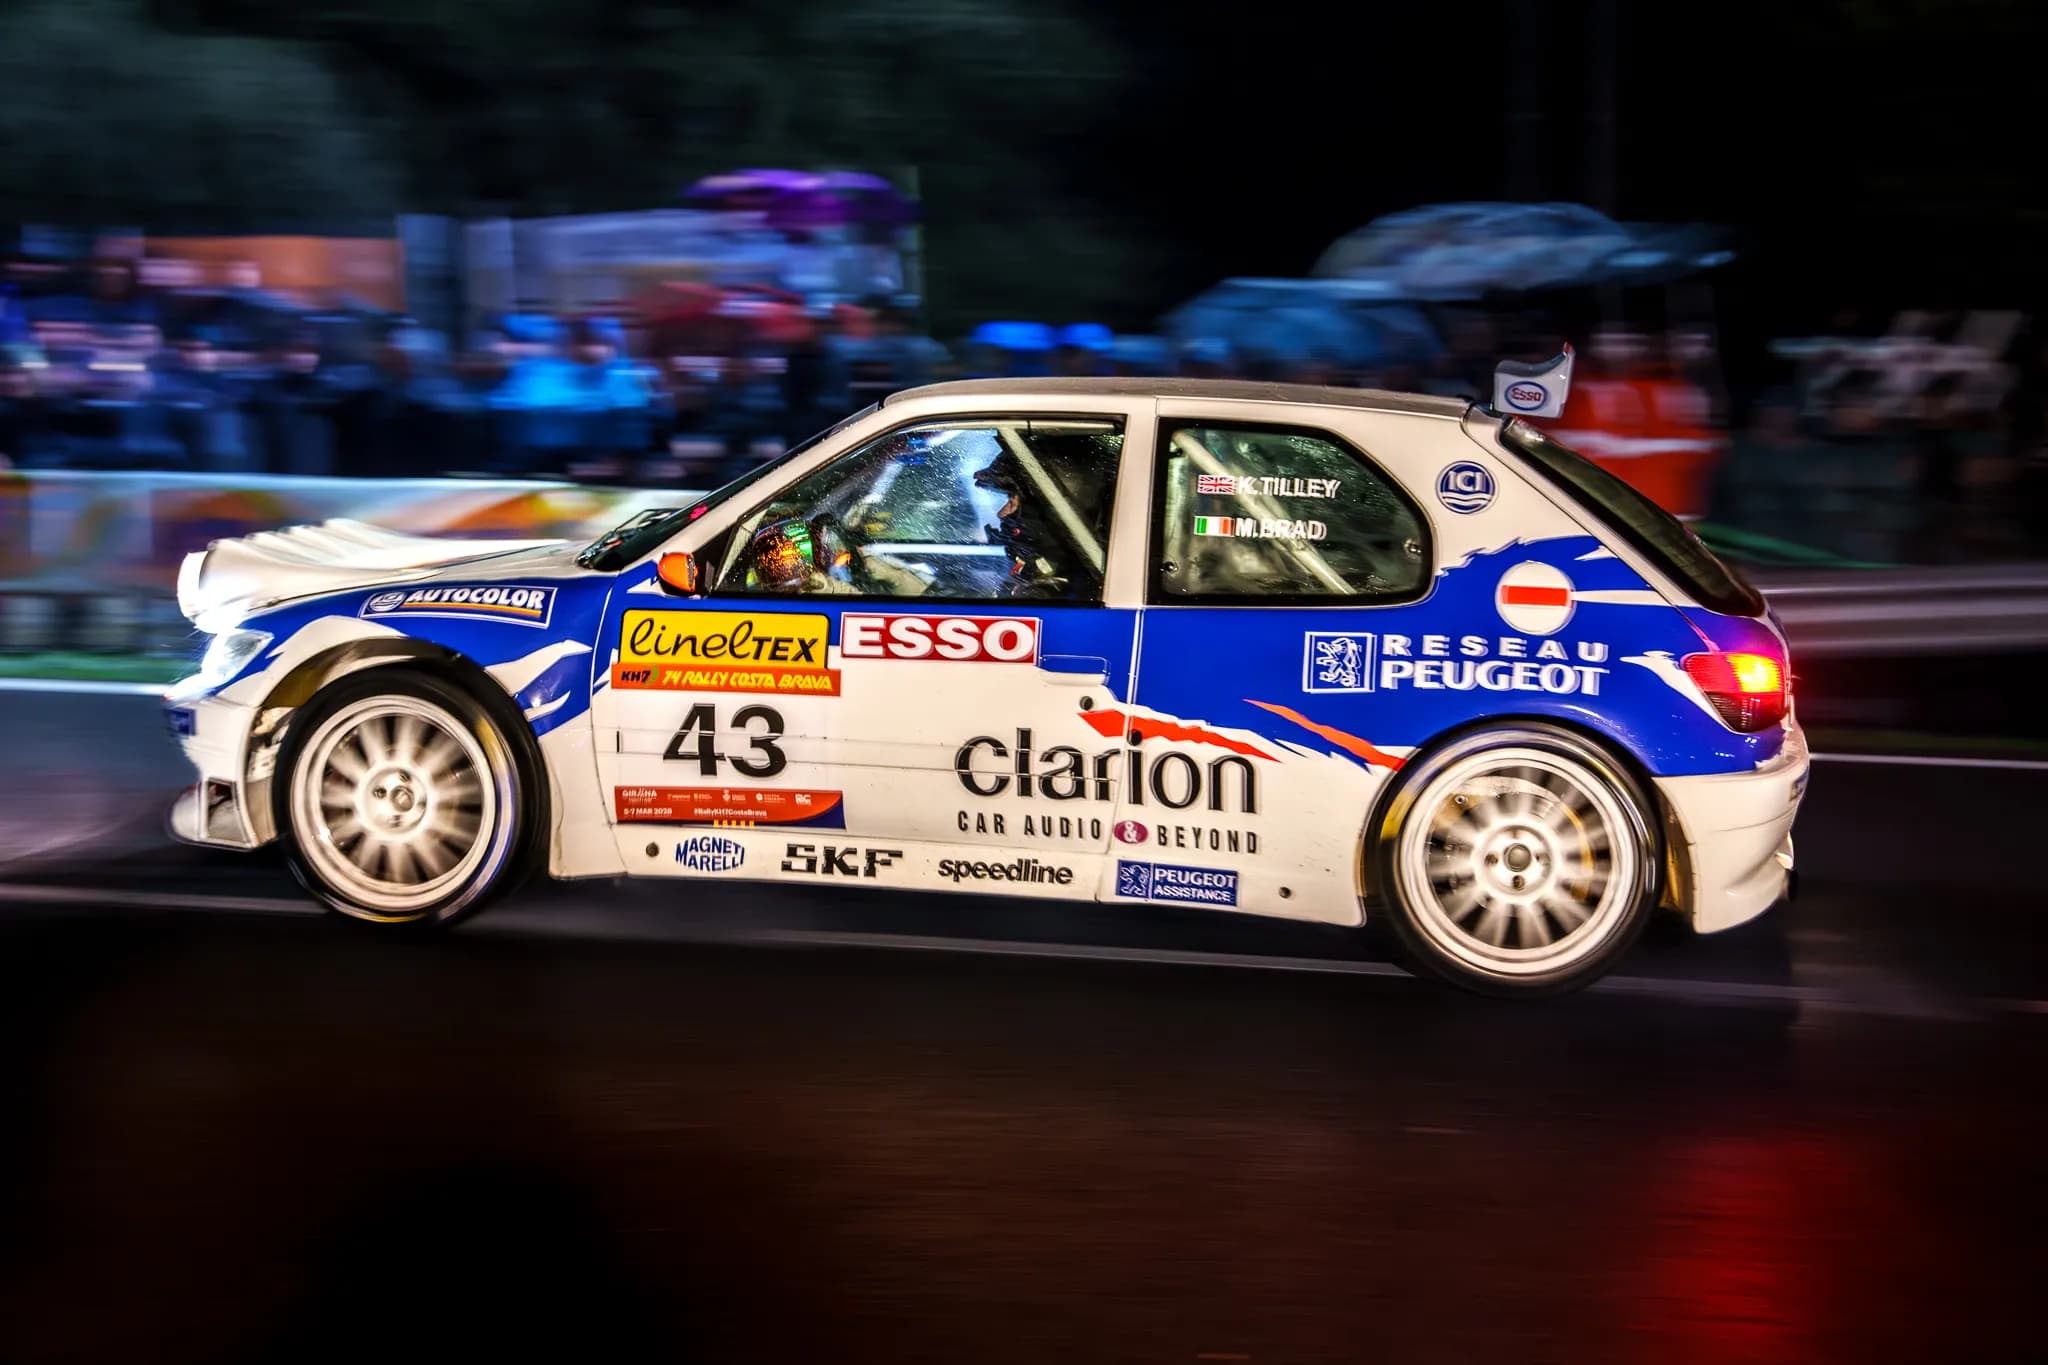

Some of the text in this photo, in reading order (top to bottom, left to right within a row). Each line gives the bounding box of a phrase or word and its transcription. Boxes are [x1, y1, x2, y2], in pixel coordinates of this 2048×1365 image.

[1237, 475, 1341, 498] K.TILLEY
[1448, 470, 1483, 491] ICI
[1235, 517, 1327, 540] M.BRAD
[406, 587, 546, 609] AUTOCOLOR
[843, 617, 1035, 661] ESSO
[1382, 633, 1609, 662] RESEAU
[620, 670, 834, 690] KH7 74 RALLY COSTA BRAVA
[1380, 659, 1610, 696] PEUGEOT
[663, 702, 787, 777] 43
[954, 727, 1258, 814] clarion
[635, 807, 652, 816] MAR
[957, 810, 1005, 835] CAR
[1024, 814, 1102, 840] AUDIO
[1157, 825, 1258, 854] BEYOND
[675, 836, 745, 860] MAGNETI
[781, 843, 903, 877] SKF
[937, 858, 1074, 884] speedline
[1154, 868, 1237, 888] PEUGEOT
[1154, 884, 1231, 902] ASSISTANCE
